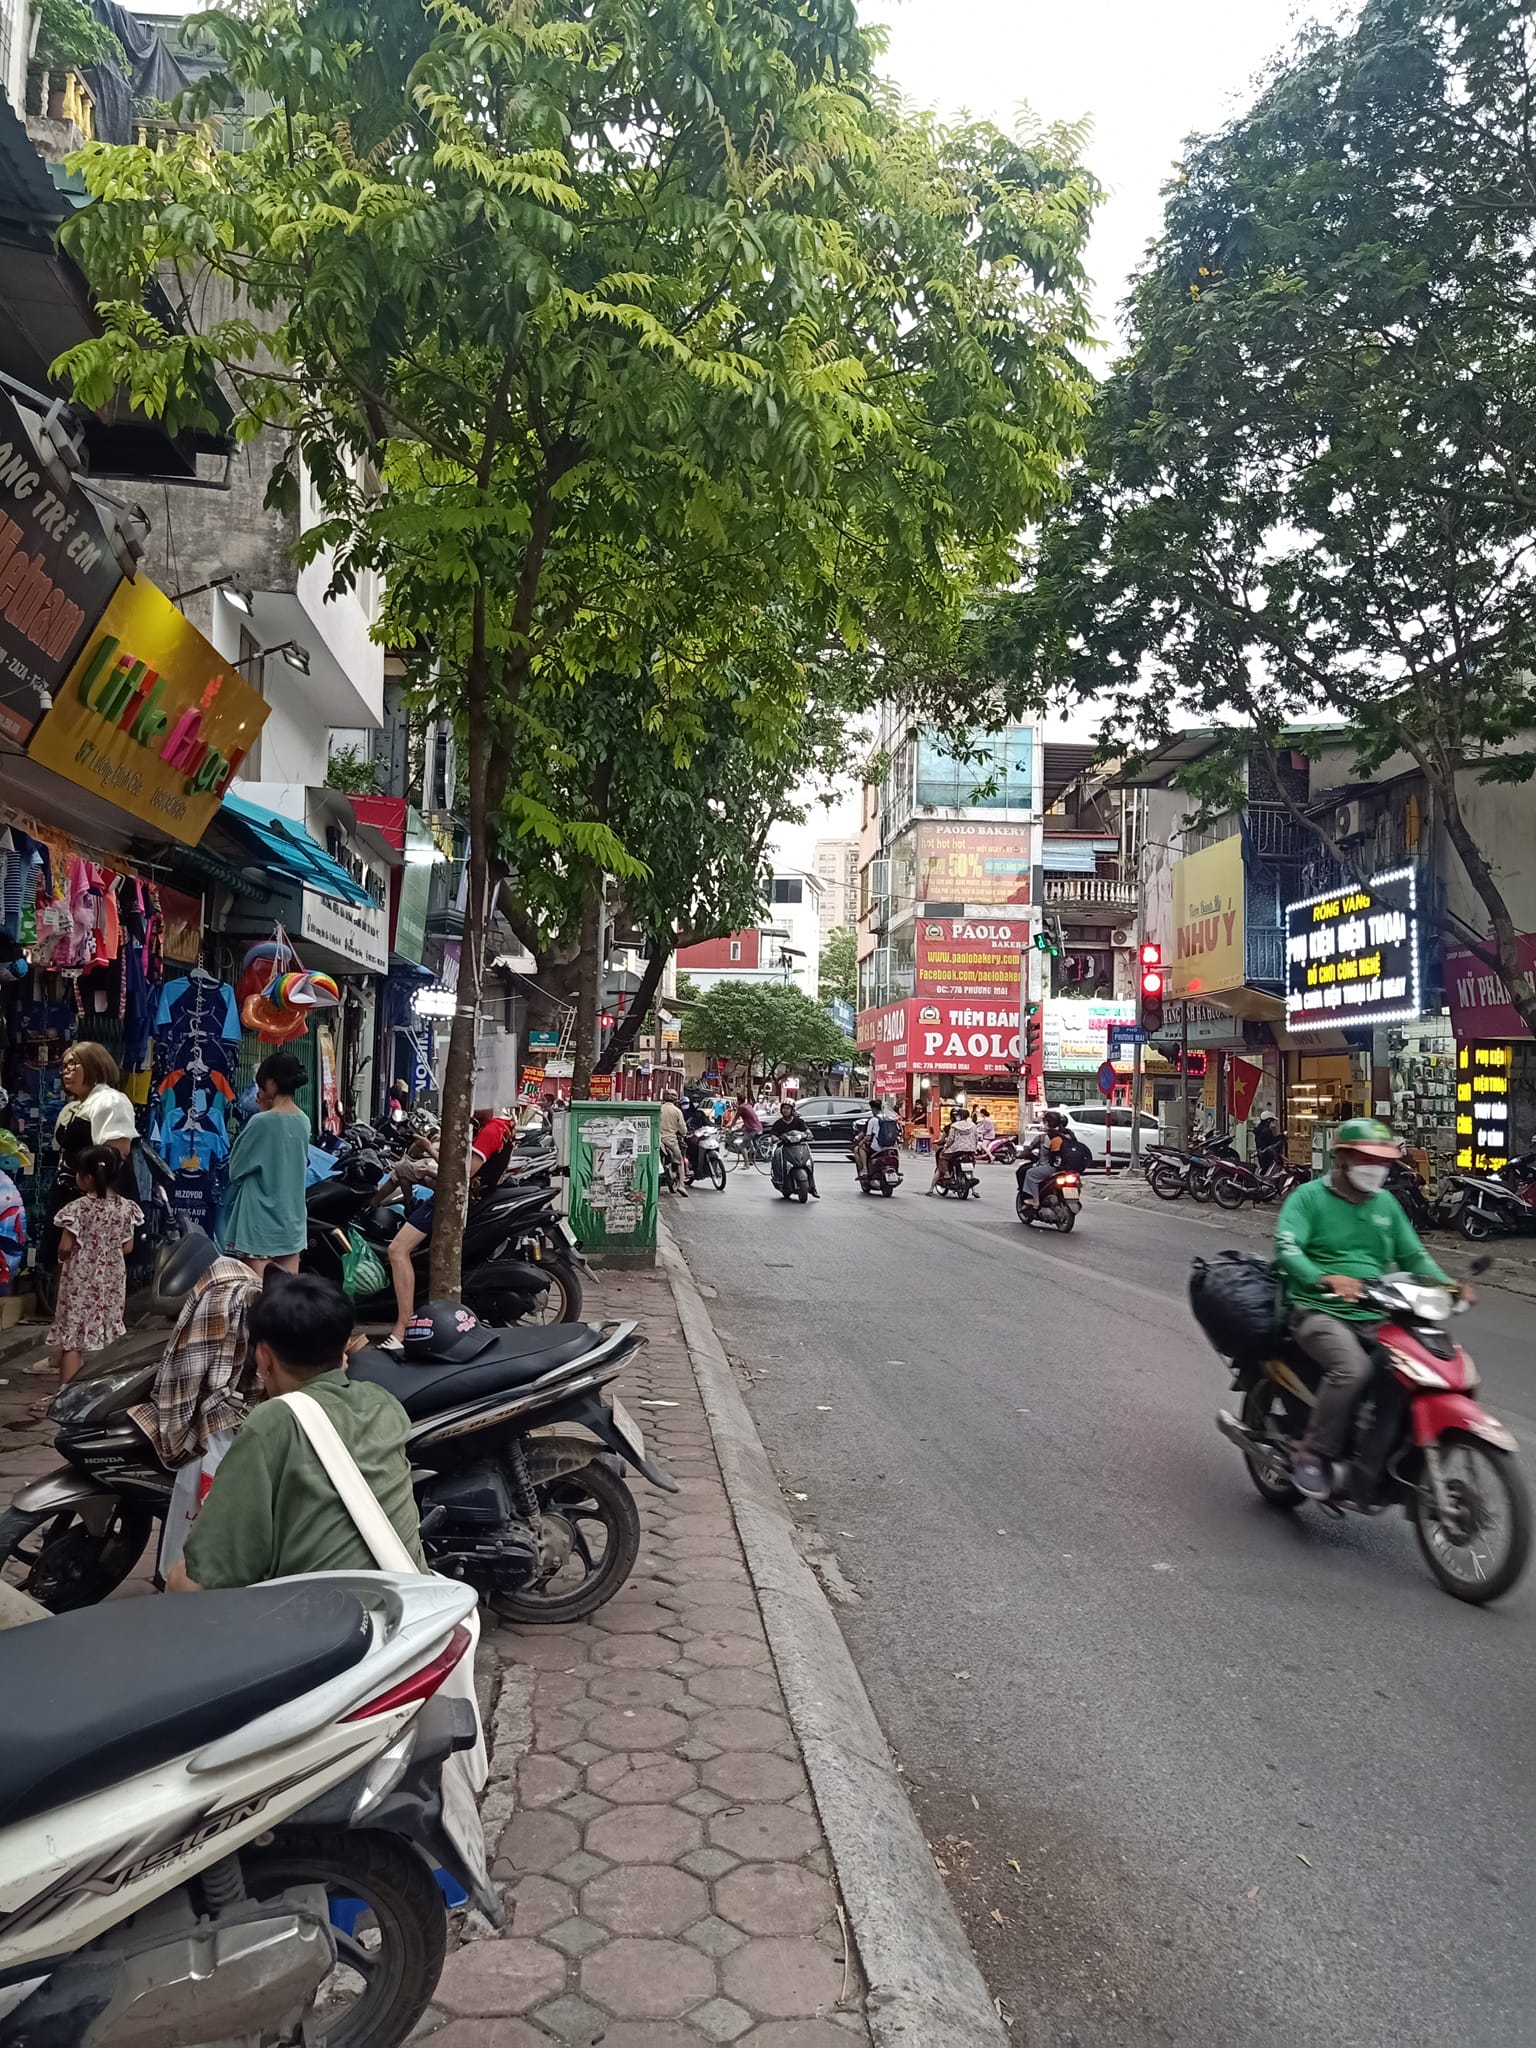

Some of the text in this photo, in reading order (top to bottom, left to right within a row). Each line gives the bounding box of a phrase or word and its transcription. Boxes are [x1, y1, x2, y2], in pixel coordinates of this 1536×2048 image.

[32, 489, 79, 542] TRẺ
[66, 530, 101, 575] EM
[78, 634, 167, 748] Little
[159, 706, 247, 800] Angel
[921, 838, 966, 850] hot hot hot
[936, 825, 1026, 836] PAOLO BAKERY
[948, 852, 983, 878] 50%
[952, 924, 1011, 940] PAOLO
[1177, 897, 1236, 960] NHƯ Ý
[1309, 922, 1335, 963] KIỆN
[1338, 914, 1366, 957] ĐIỆN
[1367, 911, 1407, 948] THOẠI
[1337, 958, 1358, 981] CÔNG
[1358, 950, 1381, 978] NGHỆ
[994, 987, 1008, 995] MAI
[1456, 970, 1476, 1008] MỸ
[883, 1008, 905, 1043] PAOLO
[949, 1007, 985, 1029] TIỆM
[84, 1456, 125, 1464] HONDA
